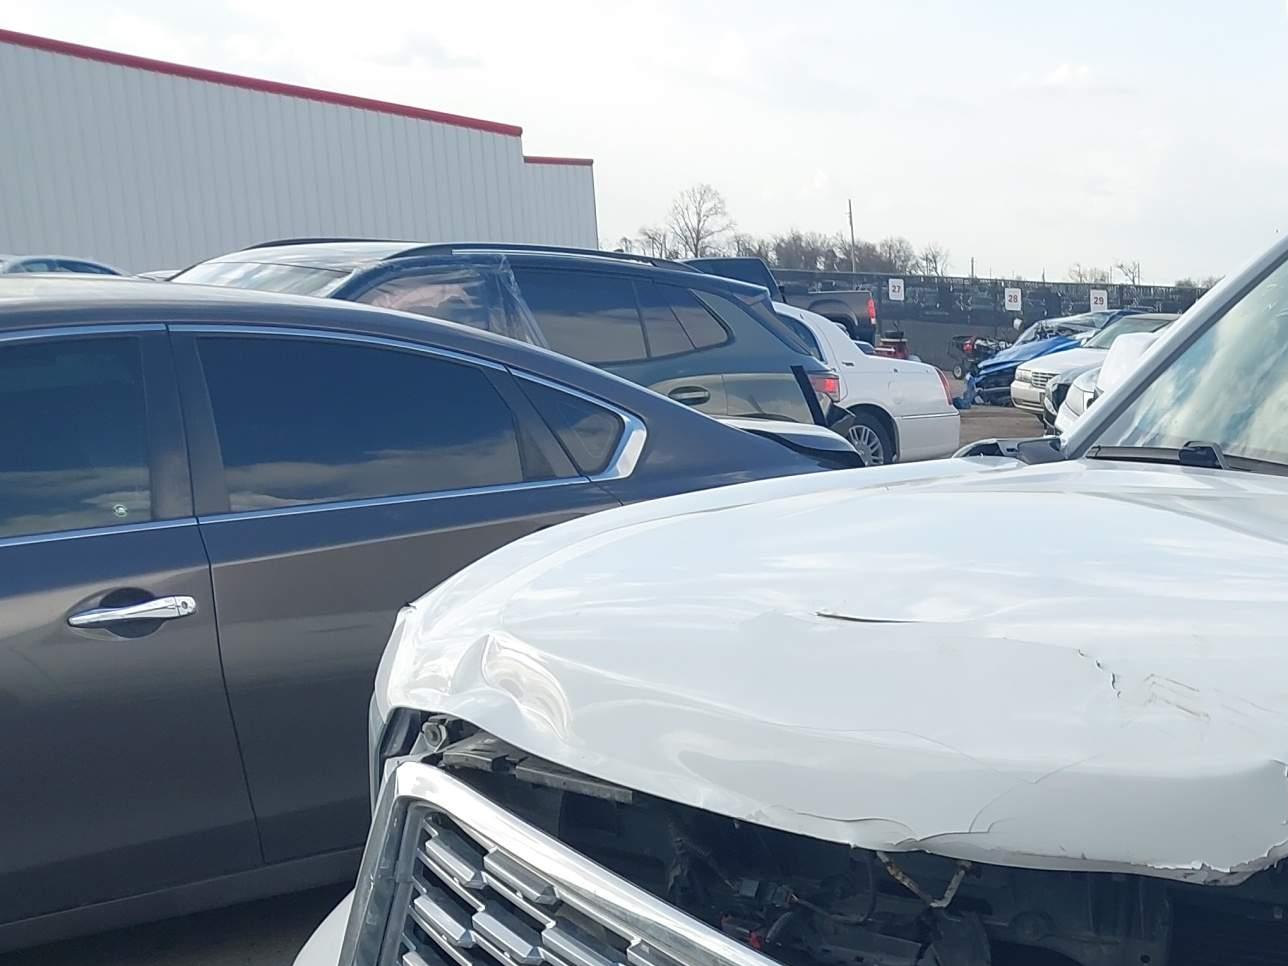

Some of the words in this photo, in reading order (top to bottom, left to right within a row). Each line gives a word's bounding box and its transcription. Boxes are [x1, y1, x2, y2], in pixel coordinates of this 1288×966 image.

[891, 284, 902, 294] 27
[1007, 294, 1018, 304] 28
[1093, 296, 1105, 306] 29
